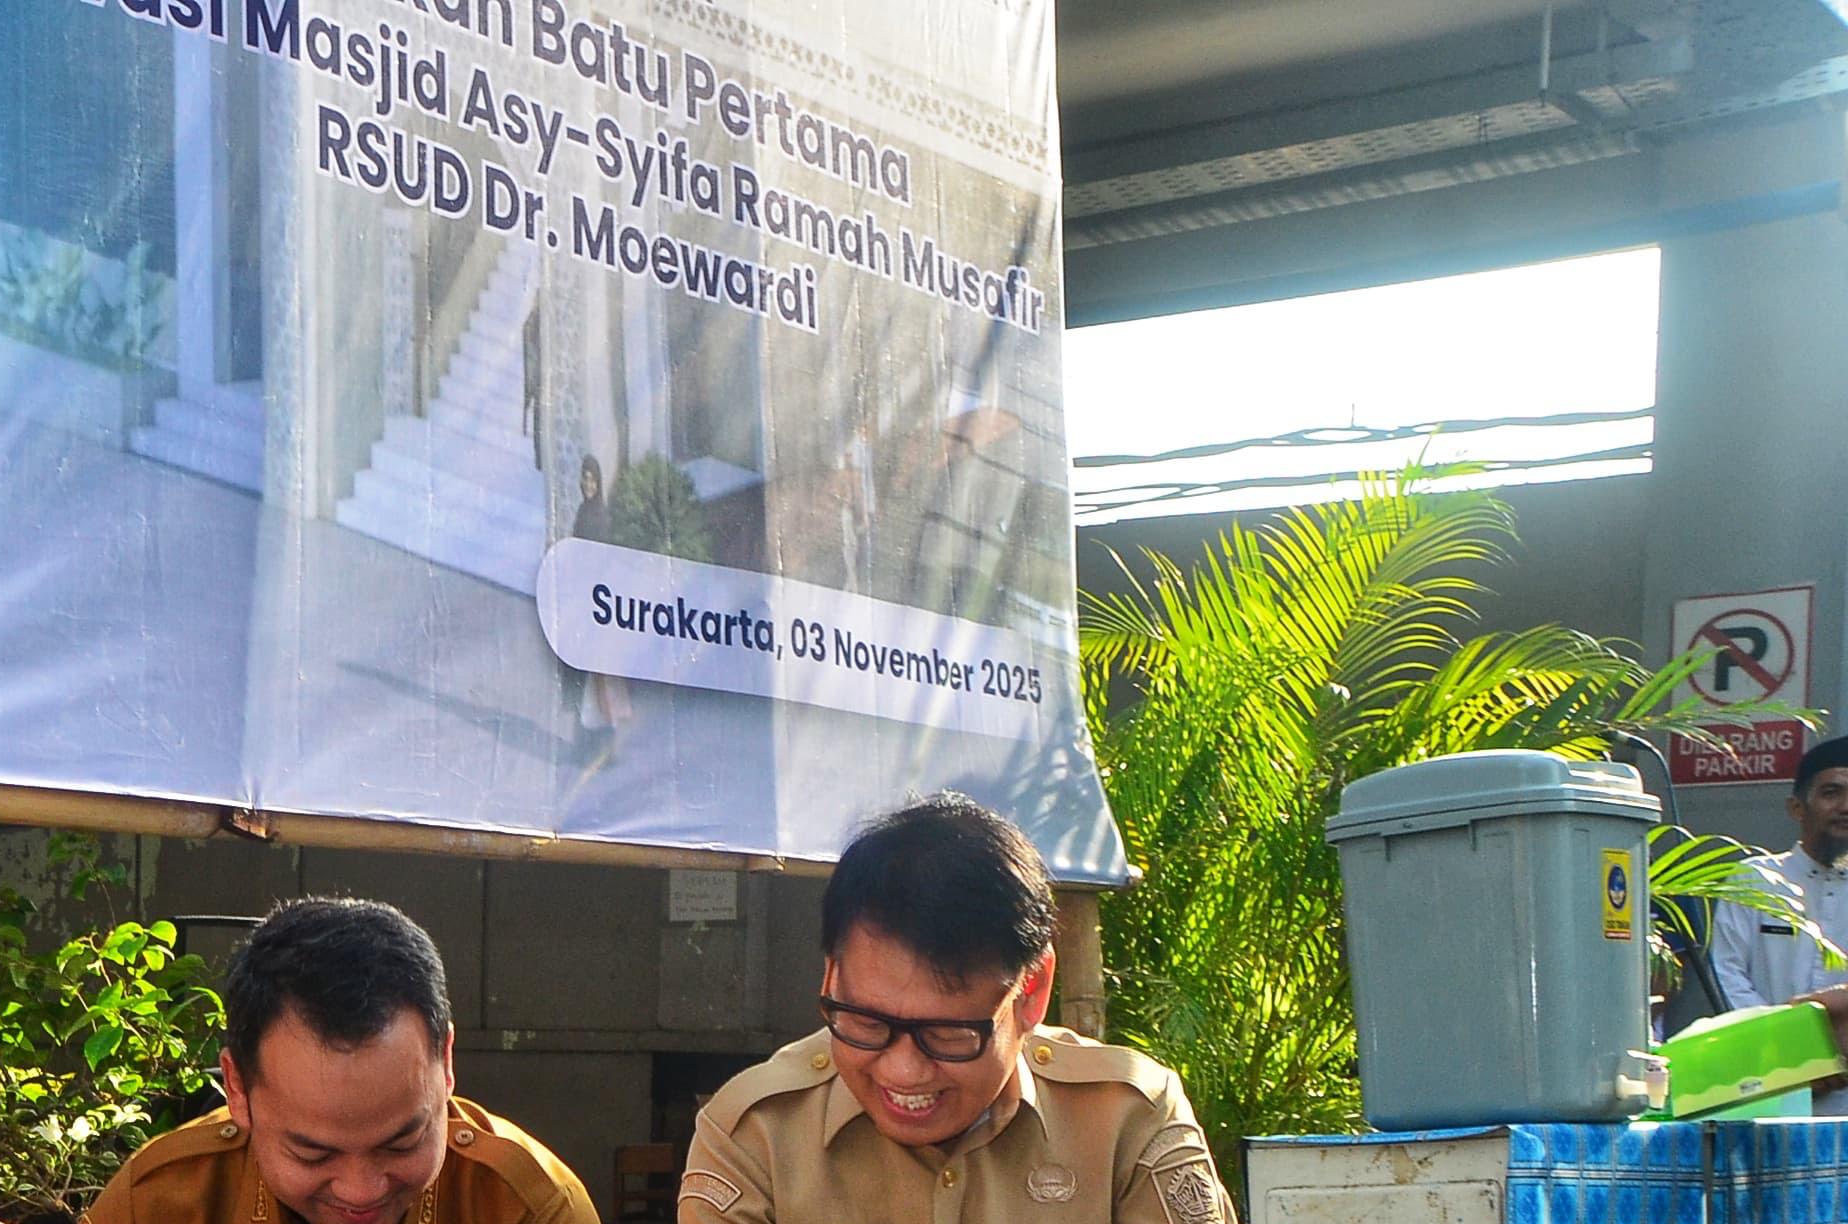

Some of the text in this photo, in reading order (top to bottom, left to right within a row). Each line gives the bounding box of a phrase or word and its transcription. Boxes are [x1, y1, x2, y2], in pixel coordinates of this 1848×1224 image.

[247, 0, 446, 115] Masjid
[463, 69, 720, 214] Asy-Syifa
[734, 166, 891, 276] Ramah
[902, 232, 1041, 331] Musafir
[533, 0, 669, 108] Batu
[685, 54, 909, 199] Pertama
[319, 104, 817, 329] RSUD Dr. Moewardi
[591, 584, 1042, 704] Surakarta, 03 November 2025
[1694, 754, 1776, 777] PARKIR
